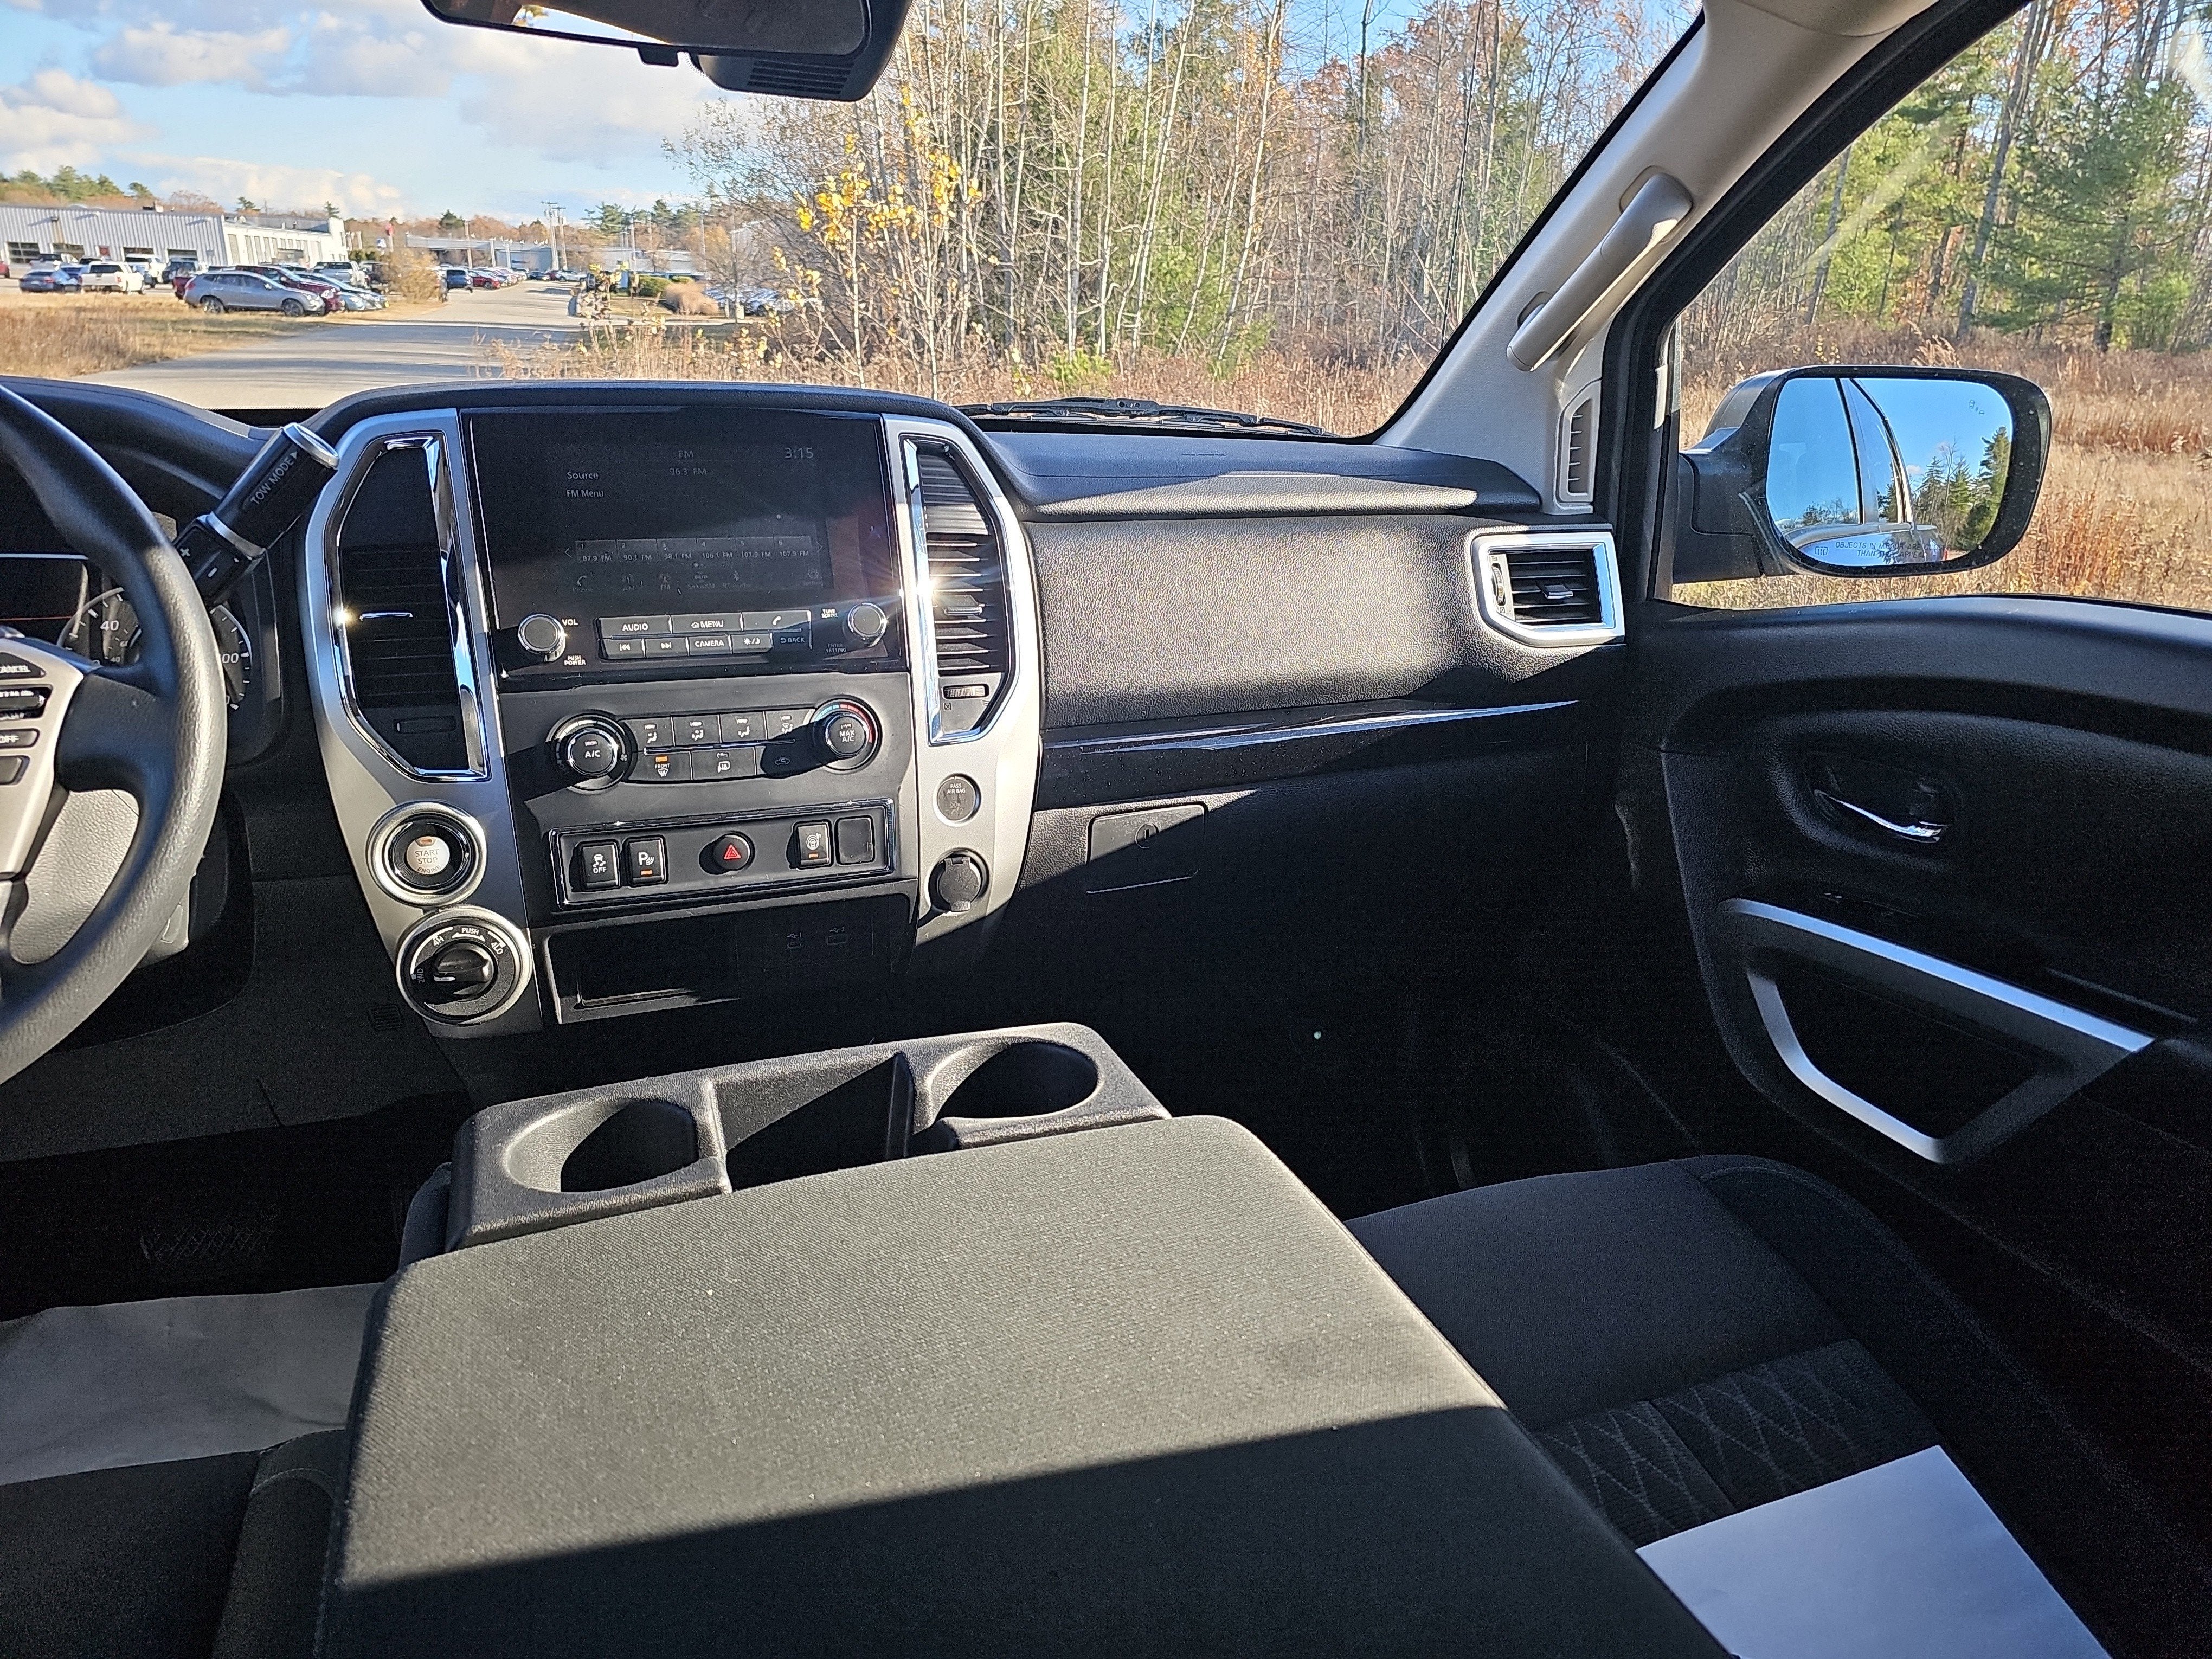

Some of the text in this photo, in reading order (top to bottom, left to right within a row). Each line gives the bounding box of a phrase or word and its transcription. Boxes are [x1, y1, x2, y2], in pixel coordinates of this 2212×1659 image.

[679, 450, 693, 458] FM
[785, 447, 814, 459] 3:15
[567, 471, 599, 479] Source
[250, 456, 294, 504] TOW MODE
[581, 489, 604, 497] Menu
[100, 620, 119, 631] 40
[622, 623, 648, 632] AUDIO
[700, 620, 724, 628] MENU
[695, 639, 724, 648] CAMERA
[585, 750, 601, 758] A/C
[415, 848, 439, 857] START
[417, 865, 440, 873] ENGINE
[434, 936, 445, 946] 4H
[491, 942, 504, 955] 4LO
[416, 968, 426, 984] 2WD
